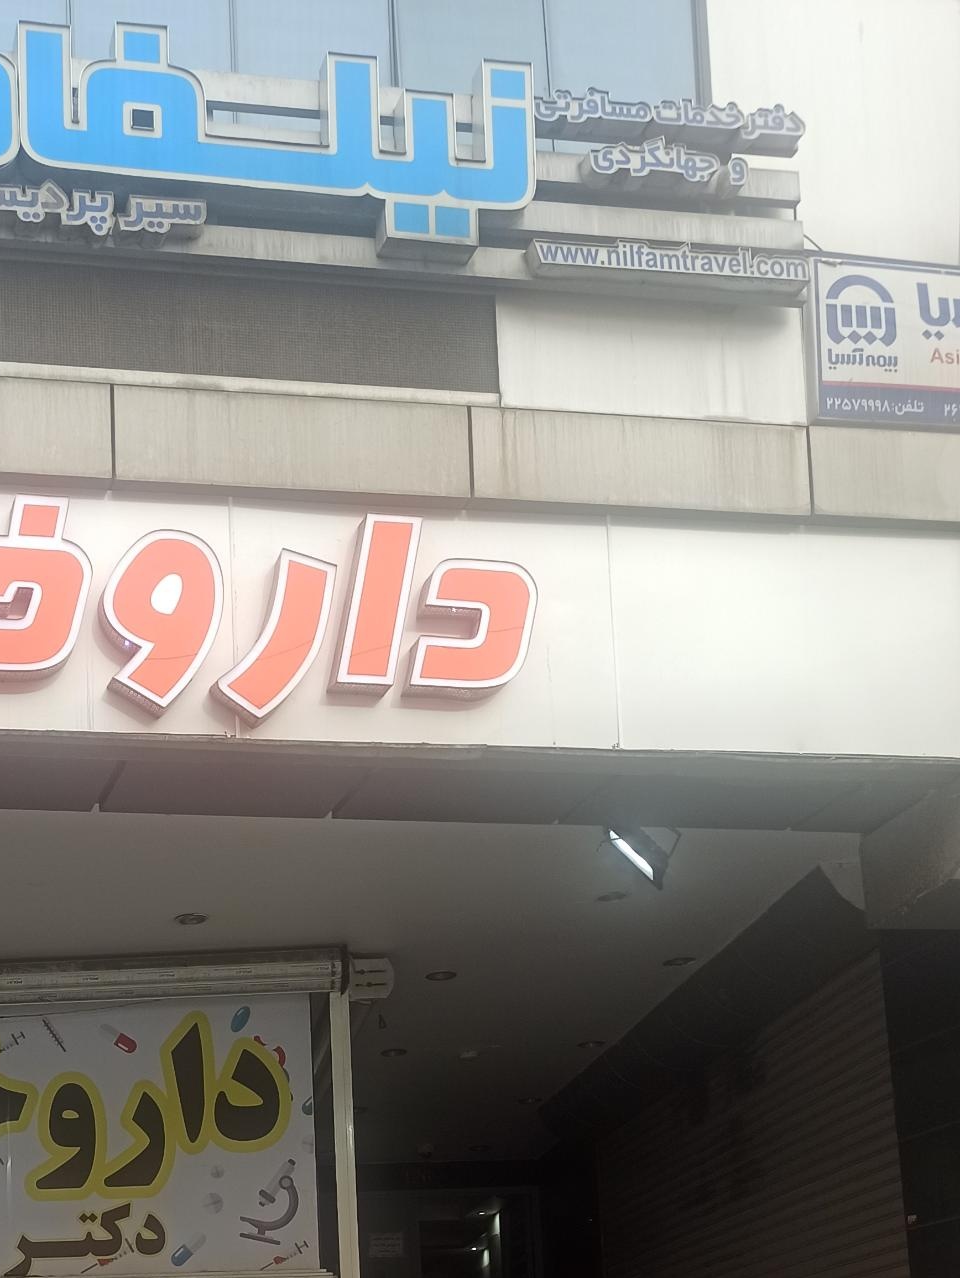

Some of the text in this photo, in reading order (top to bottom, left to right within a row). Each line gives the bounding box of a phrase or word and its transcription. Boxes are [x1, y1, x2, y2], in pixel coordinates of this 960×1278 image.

[536, 90, 804, 138] دفتر خدمات مسافرتی
[592, 138, 747, 184] و جهانگردی
[120, 196, 205, 231] سیر
[540, 242, 808, 280] www.nilfamtravel.com
[827, 347, 864, 371] آسیا
[4, 1202, 166, 1277] دکتر
